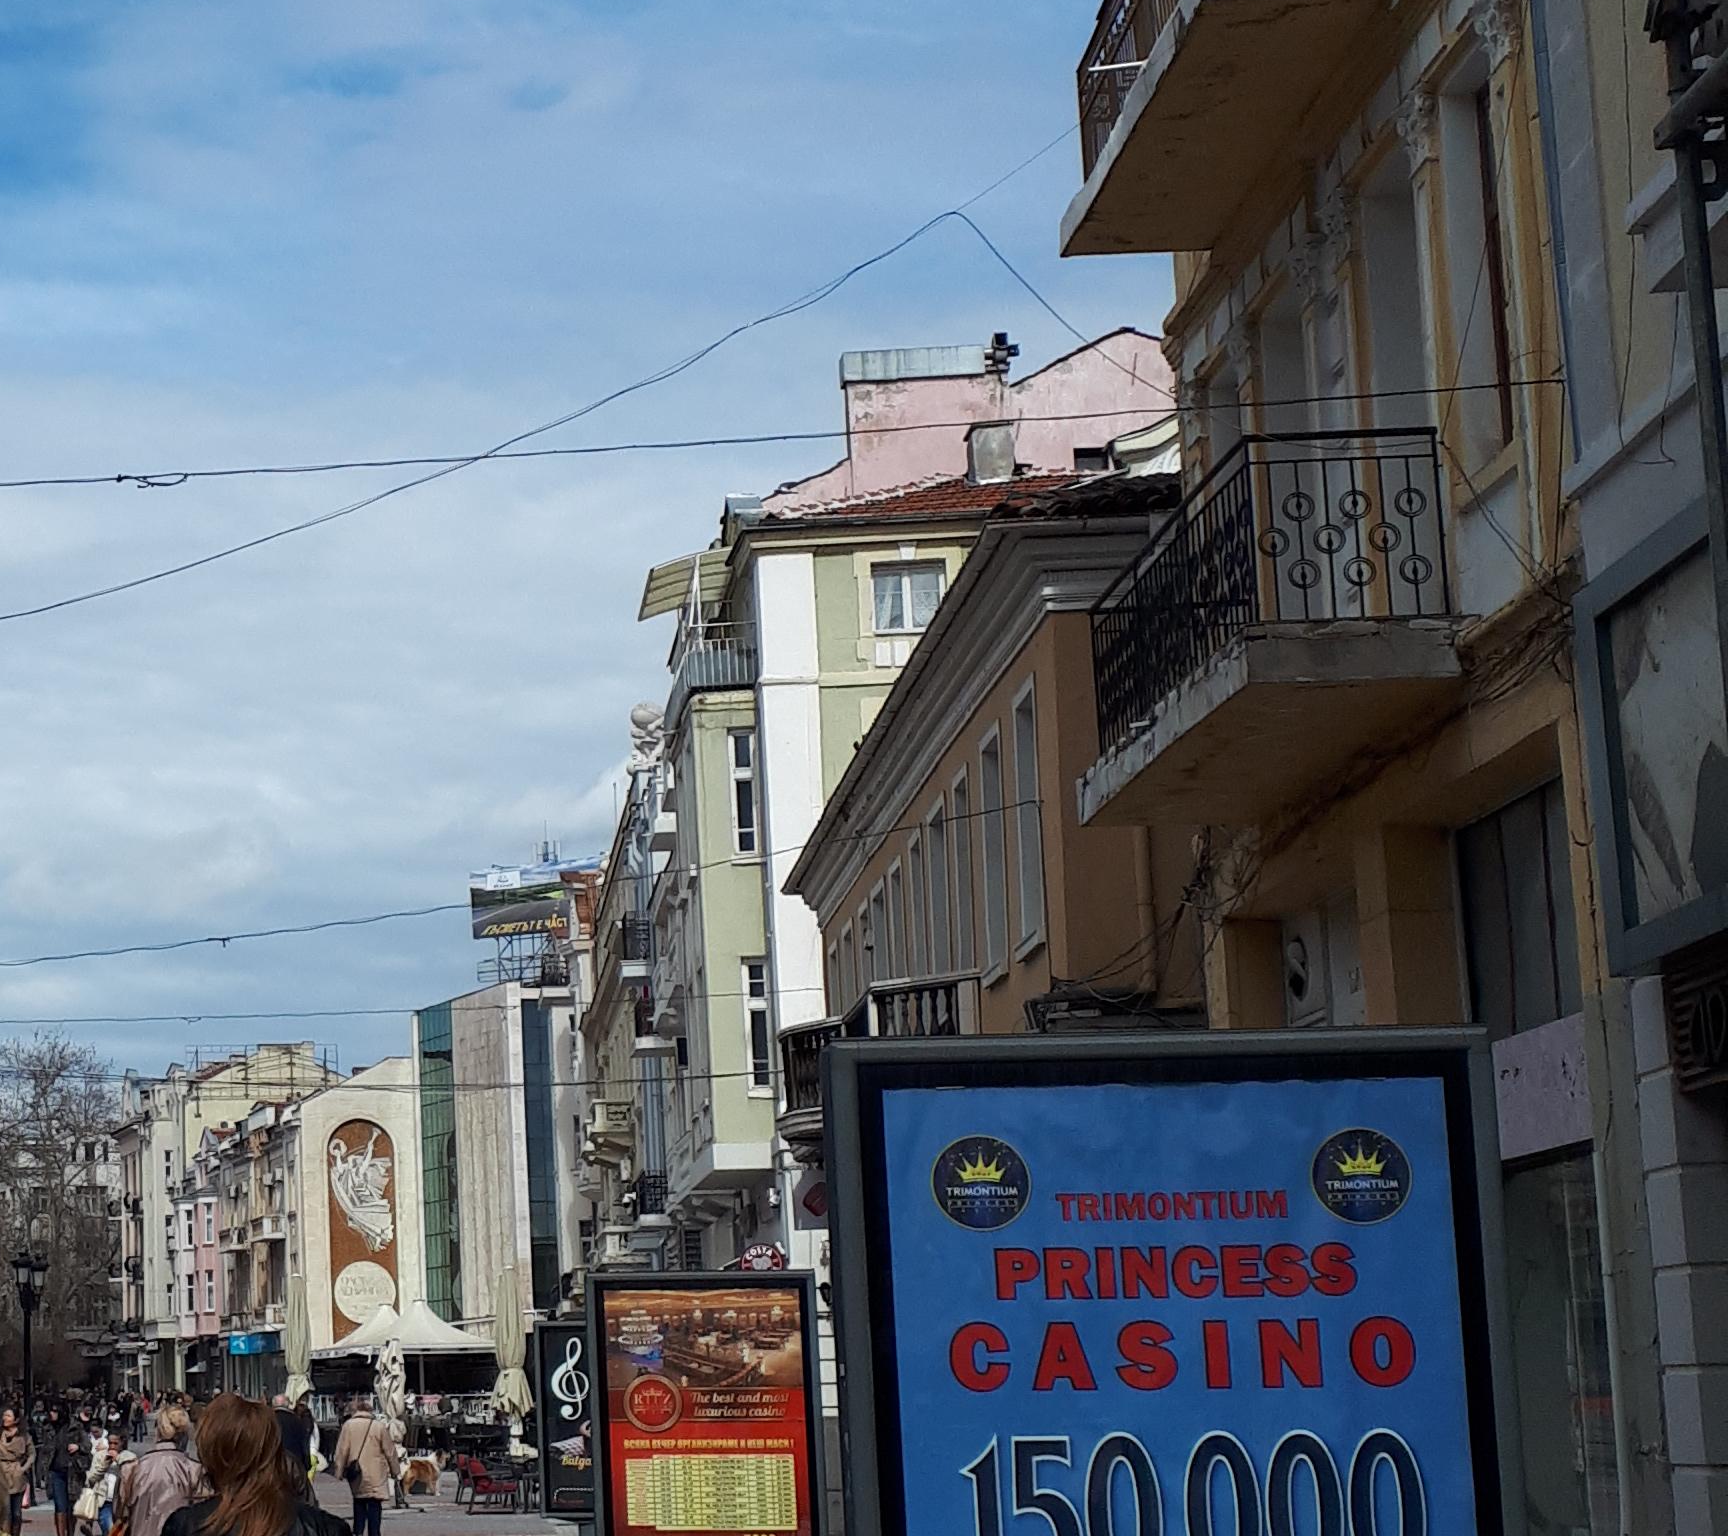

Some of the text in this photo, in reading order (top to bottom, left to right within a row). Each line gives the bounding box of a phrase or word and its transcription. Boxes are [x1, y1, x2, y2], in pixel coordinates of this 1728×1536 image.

[945, 1185, 1019, 1196] TRIMONTIUM
[1324, 1178, 1400, 1190] TRIMONTIUM
[1055, 1190, 1289, 1222] TRIMONTIUM
[993, 1241, 1359, 1301] PRINCESS
[948, 1314, 1417, 1393] CASINO
[712, 1392, 735, 1403] best
[737, 1391, 760, 1403] and
